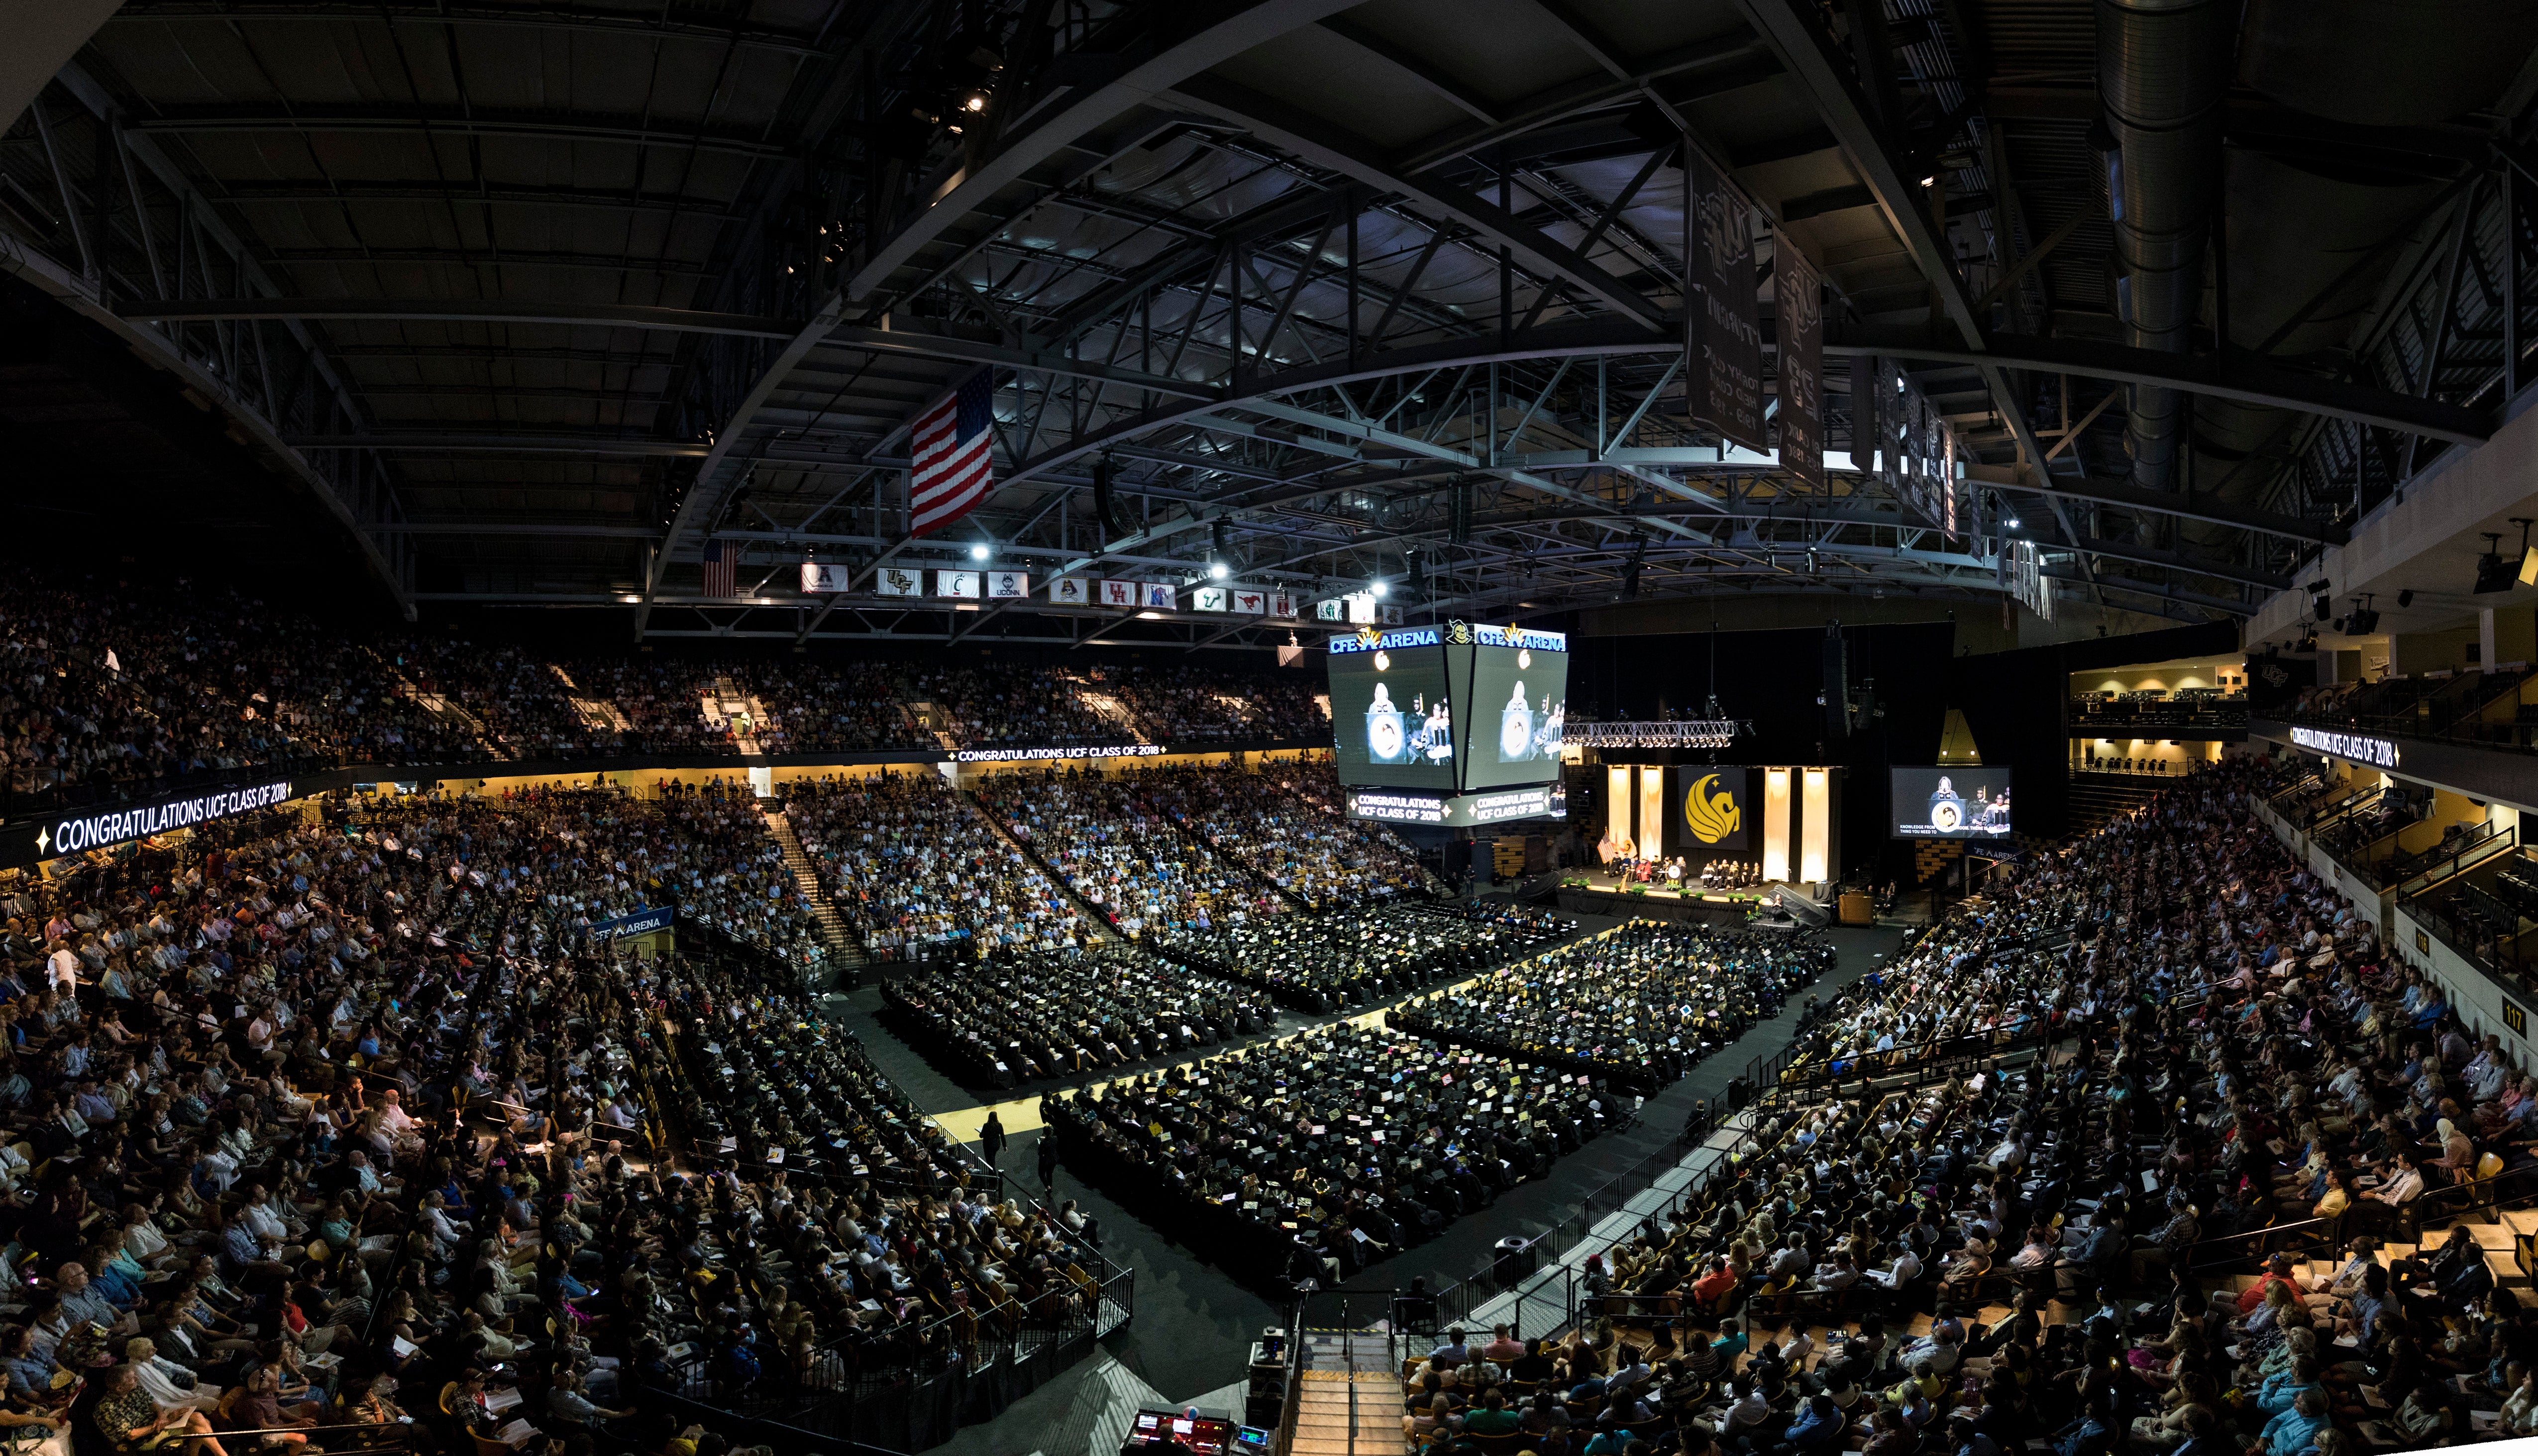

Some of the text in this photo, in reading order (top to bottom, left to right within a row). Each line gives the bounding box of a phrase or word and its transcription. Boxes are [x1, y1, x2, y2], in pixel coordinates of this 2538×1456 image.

[886, 570, 913, 594] UCF
[1330, 630, 1439, 654] CFE ARENA
[1480, 630, 1565, 651] CFE ARENA
[2260, 665, 2288, 687] UCF
[958, 745, 1160, 761] CONGRATULATIONS UCF CLASS OF 2018
[2293, 727, 2393, 767] CONGRATULATIONS UCF CLASS OF 2018
[1358, 795, 1441, 810] CONGRATULATIONS
[1477, 792, 1544, 809] CONGRATULATIONS
[56, 782, 287, 853] CONGRATULATIONS UCF CLASS OF 2018
[1358, 806, 1442, 822] UCF CLASS OF 2018
[1477, 802, 1544, 820] UCF CLASS OF 2018
[626, 918, 661, 934] ARENA
[2418, 933, 2428, 952] 116
[2506, 1004, 2522, 1031] 117
